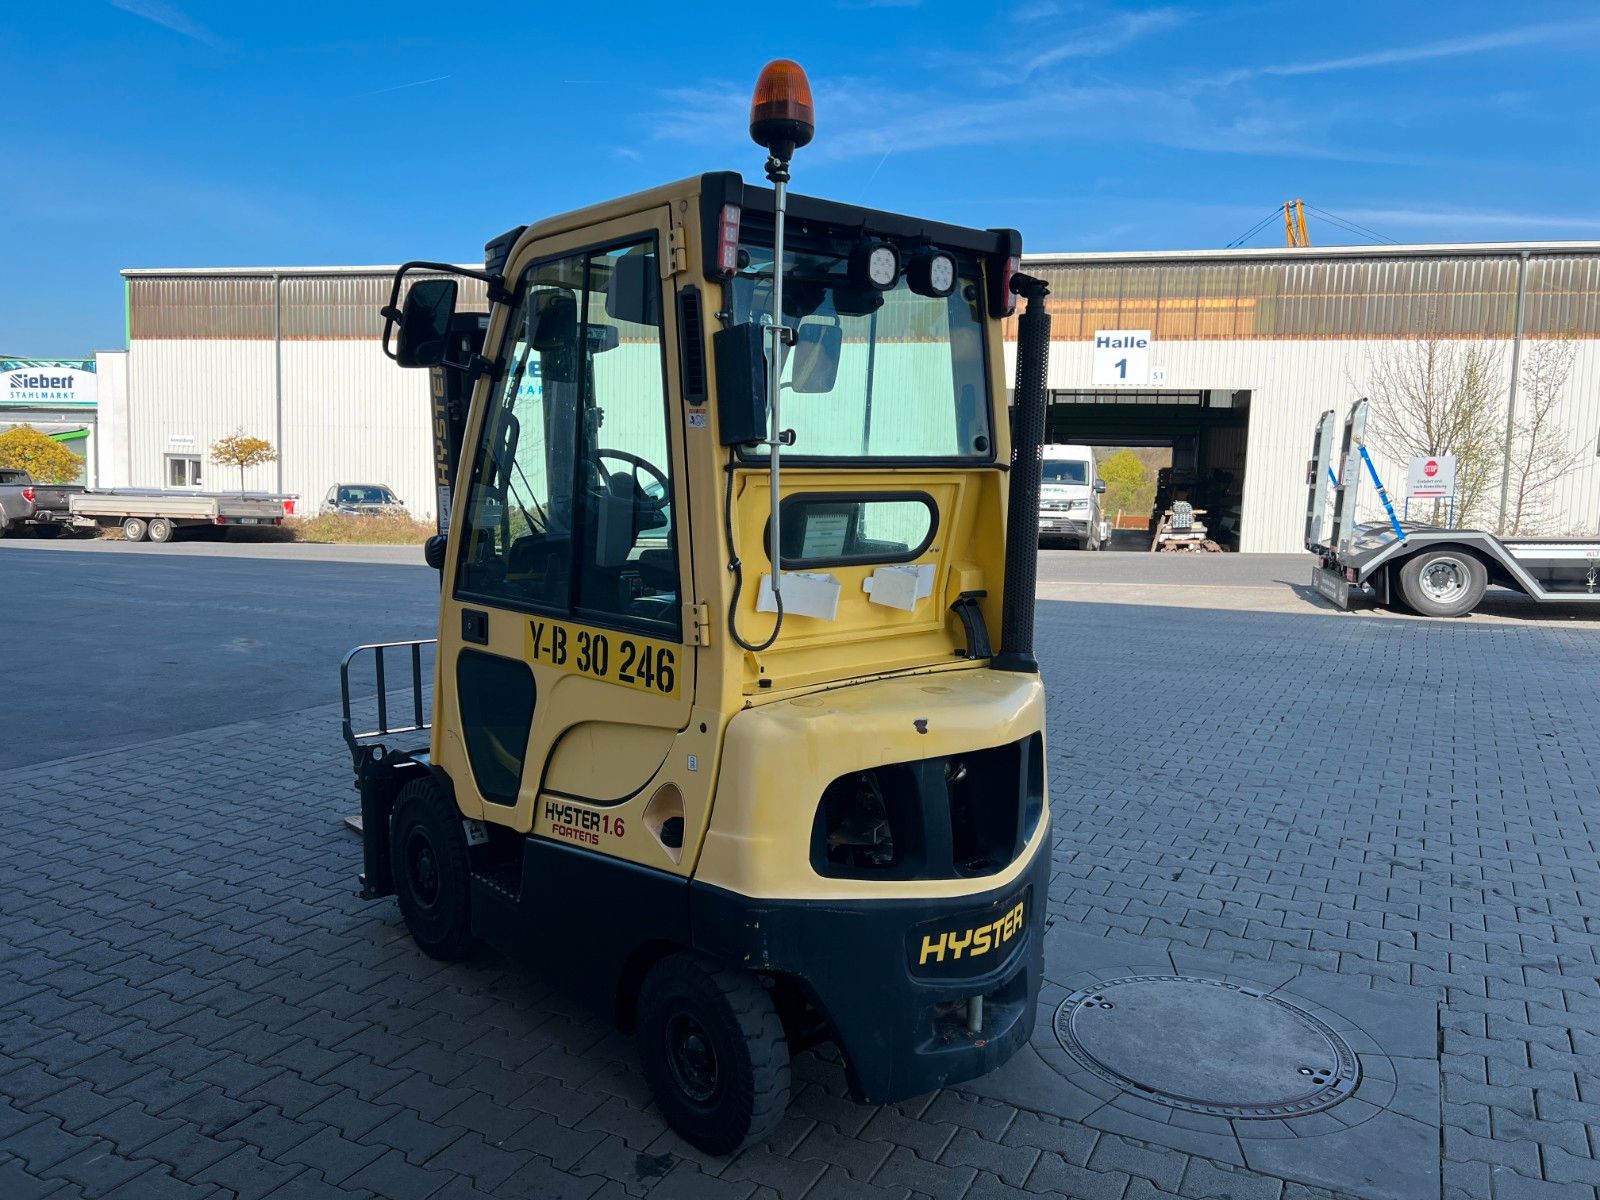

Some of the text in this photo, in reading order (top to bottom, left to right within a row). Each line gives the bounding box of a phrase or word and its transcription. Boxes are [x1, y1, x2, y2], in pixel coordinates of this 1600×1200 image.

[1096, 336, 1148, 349] Halle
[1114, 358, 1127, 379] 1
[9, 373, 75, 389] Siebert
[10, 391, 75, 399] STAHLMARKT
[529, 620, 675, 693] Y-B 30 246
[544, 802, 625, 838] HYSTER 1.6
[551, 823, 600, 845] FORTENS
[919, 901, 1024, 965] HYSTER
